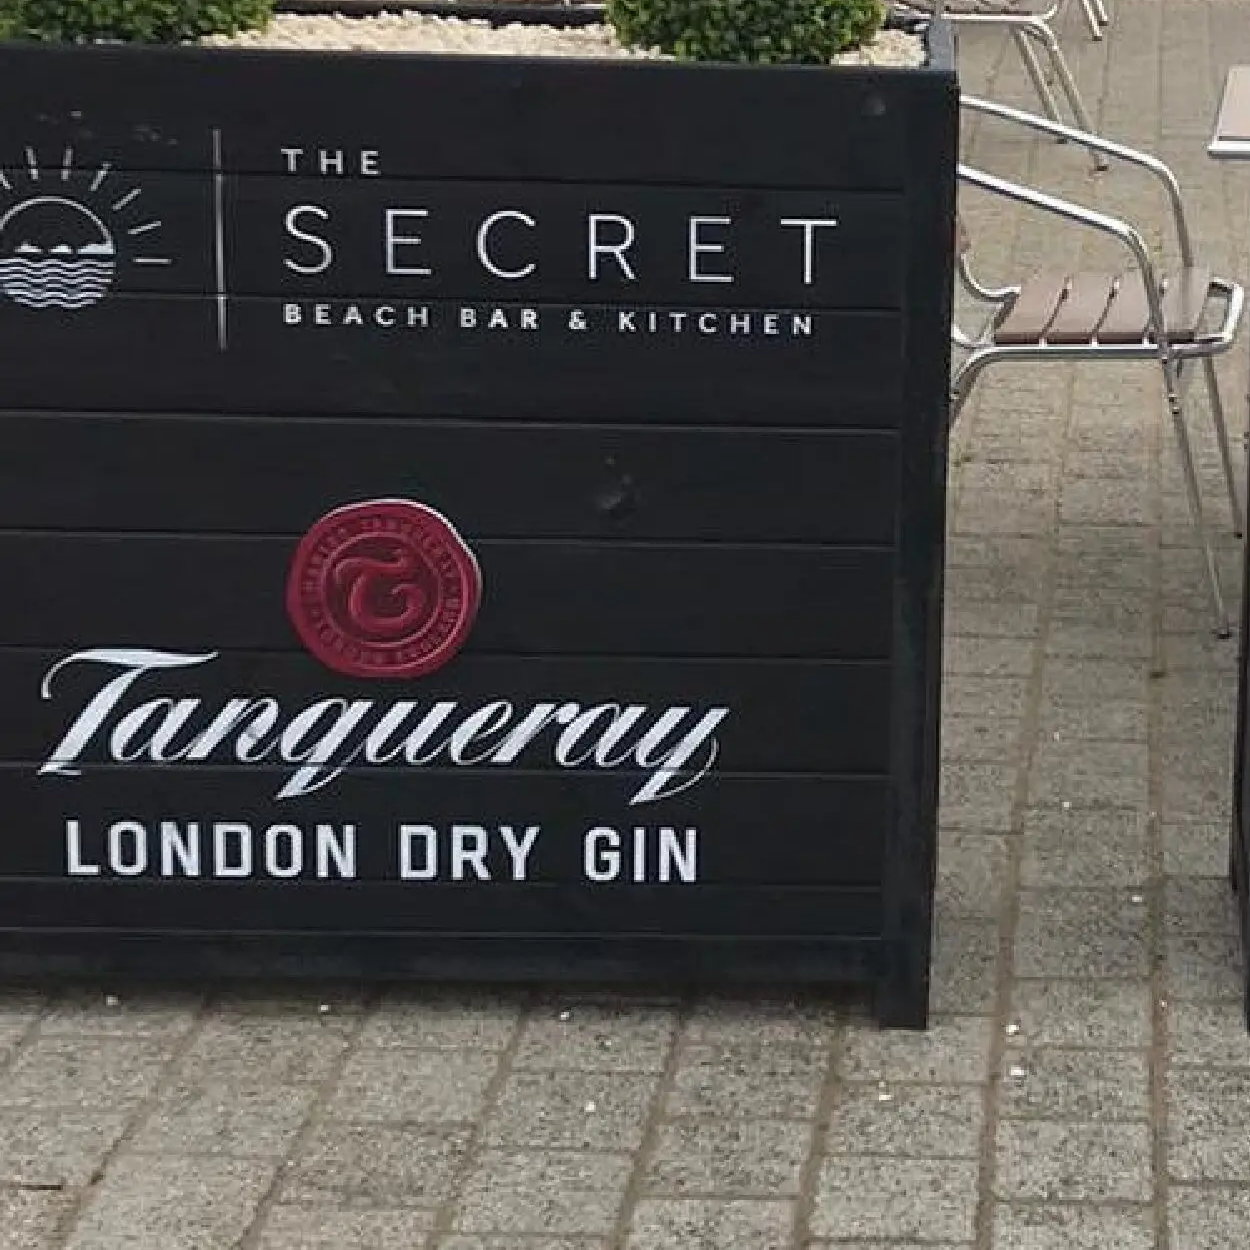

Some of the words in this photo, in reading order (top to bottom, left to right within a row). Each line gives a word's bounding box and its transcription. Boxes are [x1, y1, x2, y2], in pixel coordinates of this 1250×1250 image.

[280, 148, 379, 175] THE
[285, 205, 837, 285] SECRET
[284, 303, 429, 328] BEACH
[460, 307, 537, 330] BAR
[568, 308, 587, 330] &
[618, 311, 812, 335] KITCHEN
[38, 647, 730, 804] Tanqueray
[67, 819, 357, 878] LONDON
[400, 824, 540, 881] DRY
[584, 826, 697, 883] GIN
